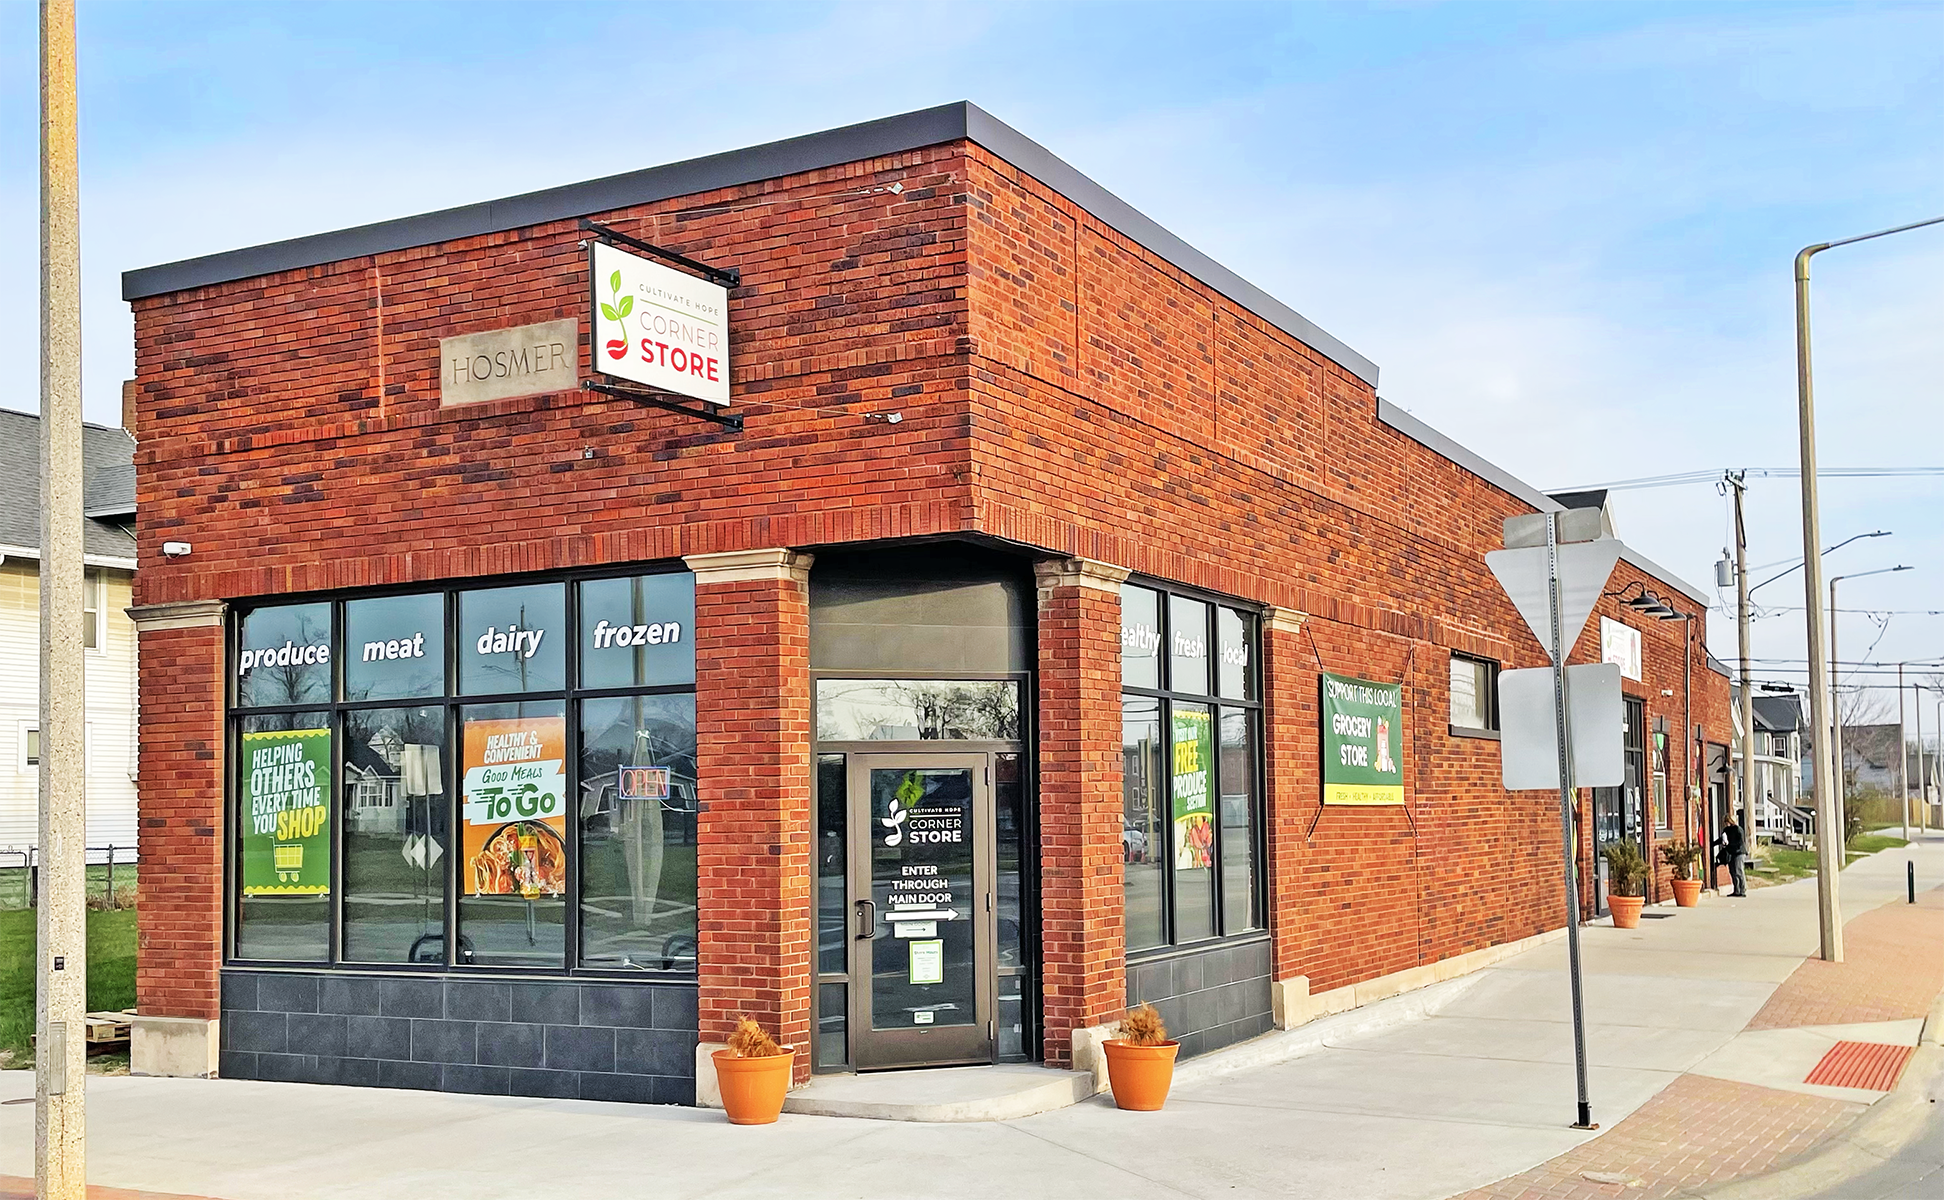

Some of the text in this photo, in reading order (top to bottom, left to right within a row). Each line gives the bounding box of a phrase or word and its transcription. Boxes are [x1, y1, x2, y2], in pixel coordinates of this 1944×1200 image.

[639, 283, 719, 317] CULTIVATE HOPE
[640, 311, 719, 352] CORNER
[452, 342, 569, 385] HOSMER
[641, 338, 719, 382] STORE
[362, 632, 425, 662] meat
[477, 624, 544, 658] dairy
[593, 619, 681, 649] frozen
[1120, 622, 1161, 658] ealthy
[1174, 630, 1204, 659] fresh
[239, 640, 330, 676] produce
[1223, 640, 1248, 667] local
[1327, 680, 1397, 708] SUPPORT THIS LOCAL
[487, 730, 538, 750] HEALTHY &
[1332, 713, 1372, 738] GROCERY
[252, 742, 303, 769] HELPING
[484, 744, 543, 764] CONVENIENT
[1174, 740, 1199, 775] FREE
[1340, 744, 1368, 767] STORE
[250, 760, 315, 796] OTHERS
[621, 769, 667, 797] OPEN
[1173, 770, 1207, 799] PRODUCE
[252, 786, 321, 816] EVERY TIME
[253, 805, 327, 841] YOU SHOP
[909, 818, 962, 829] CORNER
[909, 830, 962, 843] STORE
[891, 879, 948, 890] THROUGH
[901, 865, 938, 876] ENTER
[888, 893, 952, 904] MAIN DOOR
